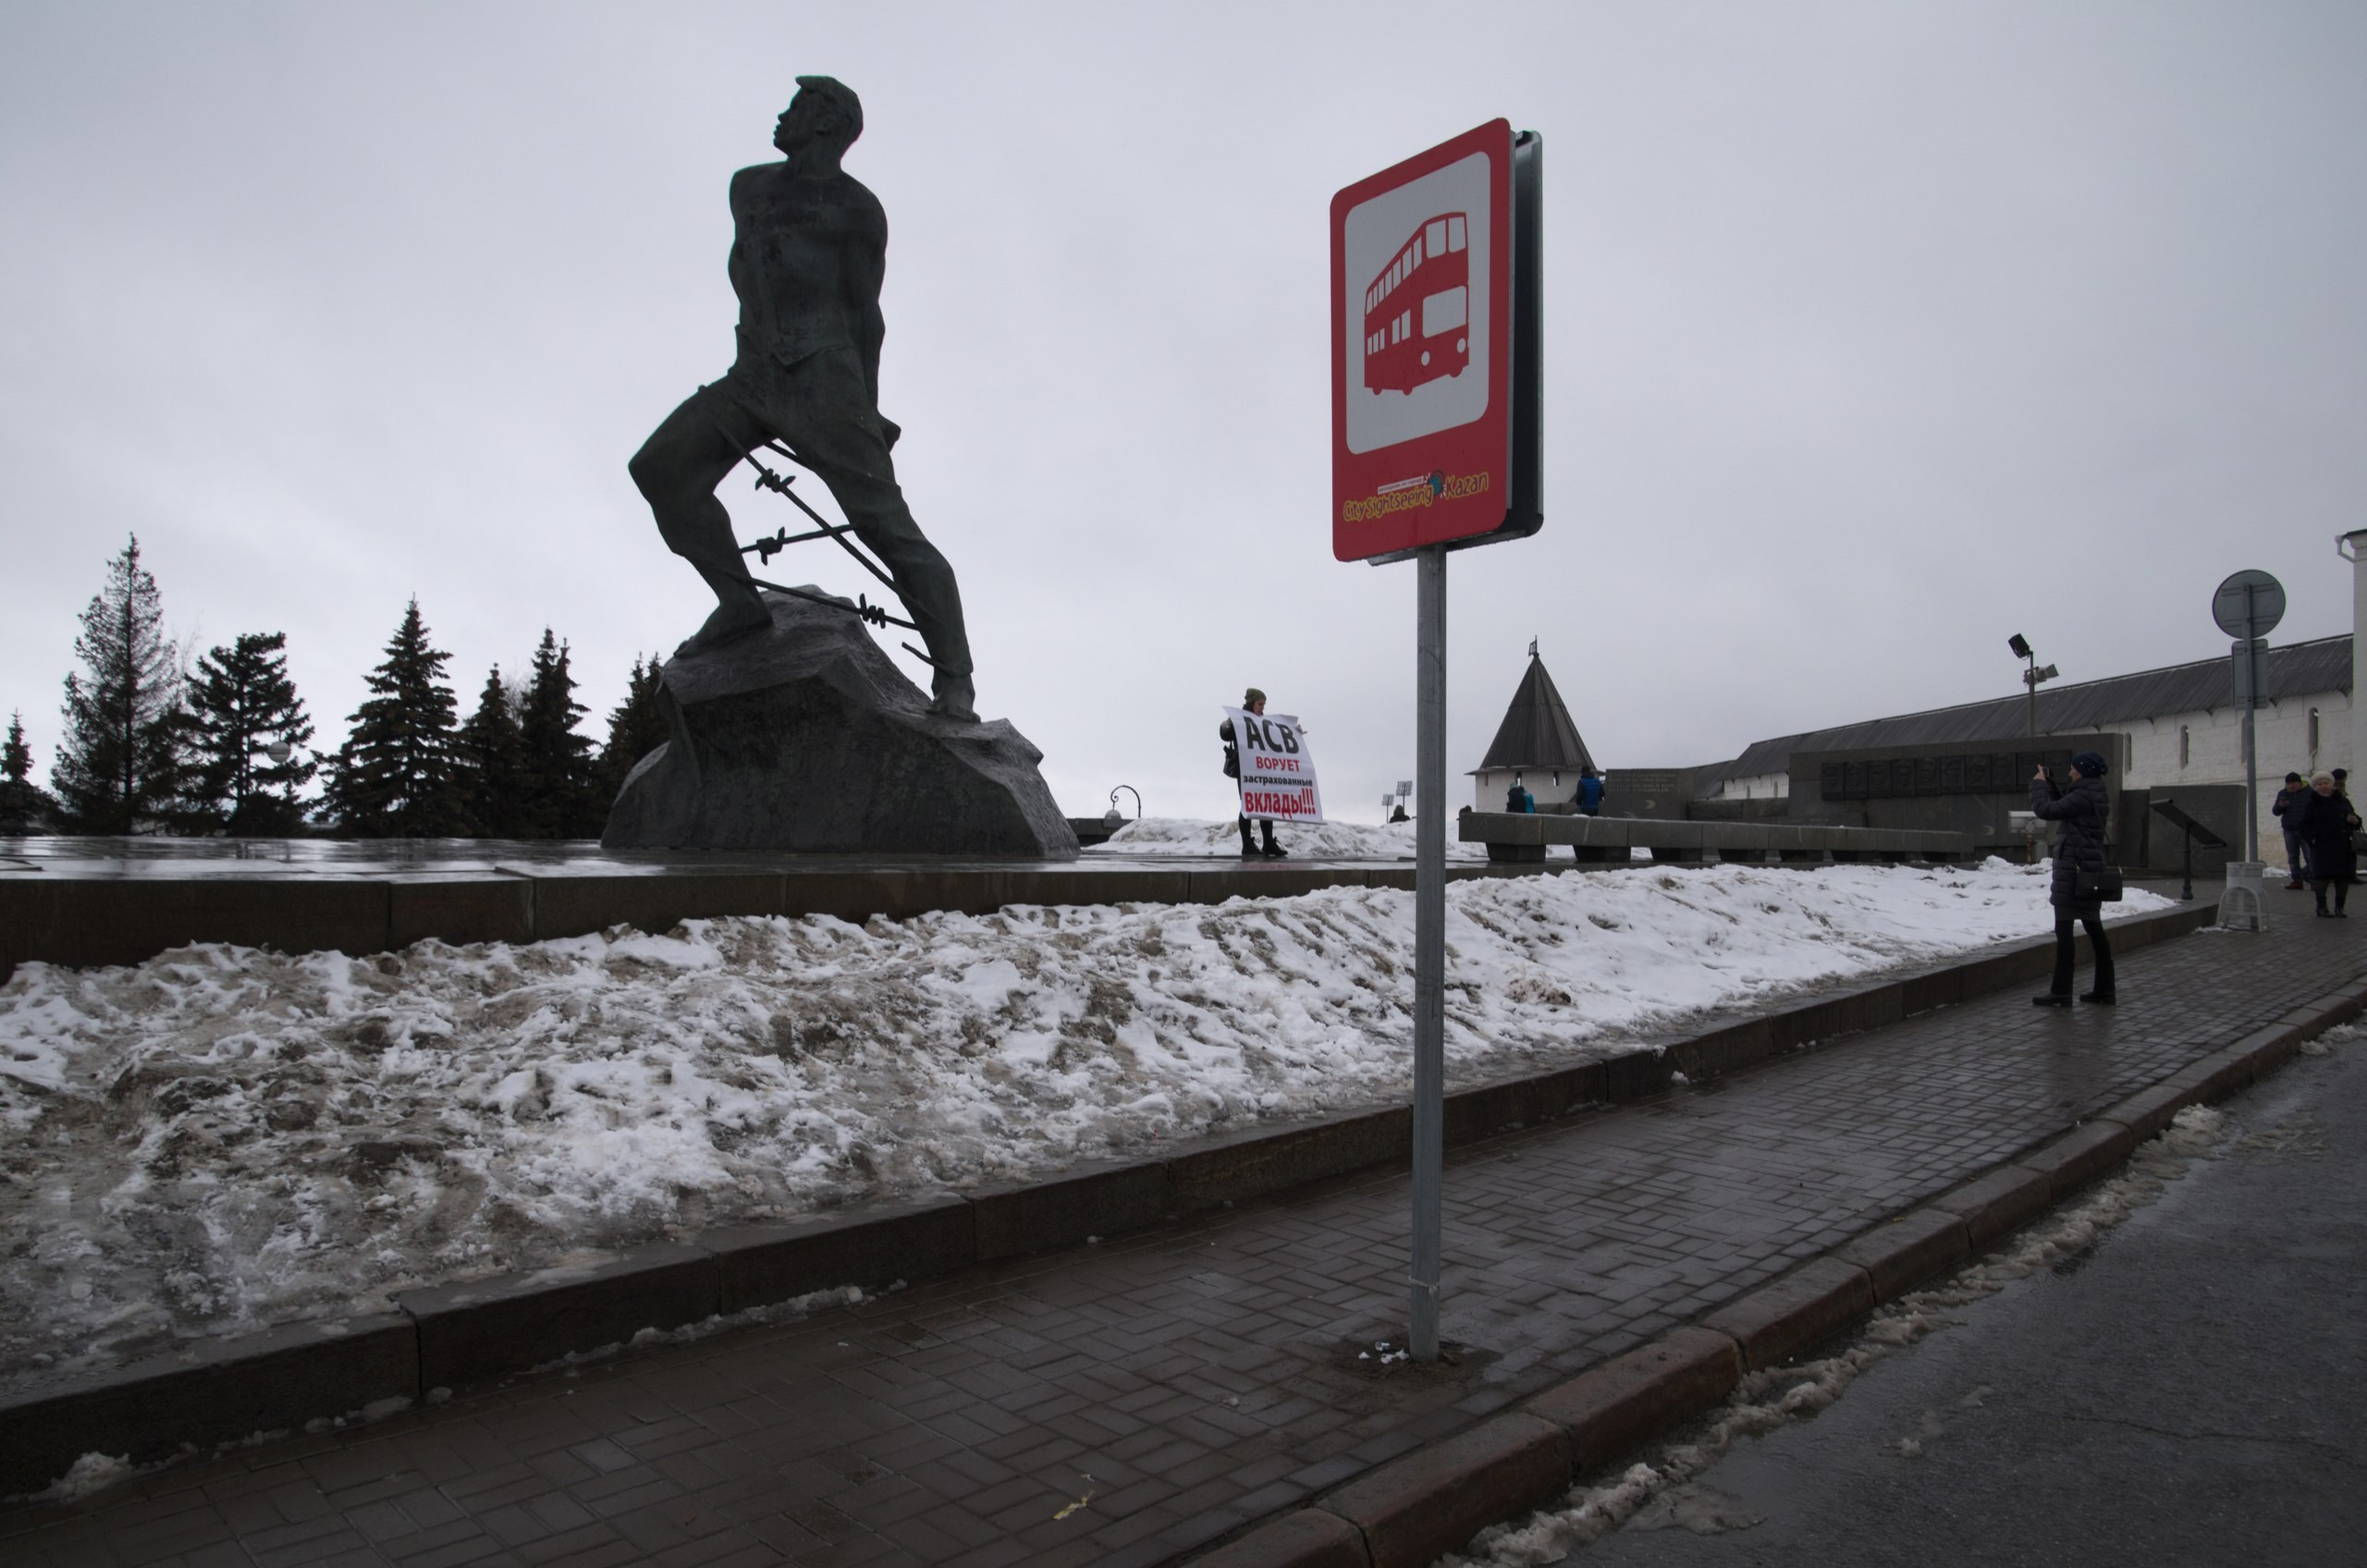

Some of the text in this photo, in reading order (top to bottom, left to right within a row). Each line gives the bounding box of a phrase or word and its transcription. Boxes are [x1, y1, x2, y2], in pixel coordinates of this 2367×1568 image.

[1446, 472, 1488, 498] Kazan
[1243, 716, 1299, 754] АСВ
[1256, 755, 1299, 772] ВОРУЕТ
[1243, 775, 1313, 787] застрахованные
